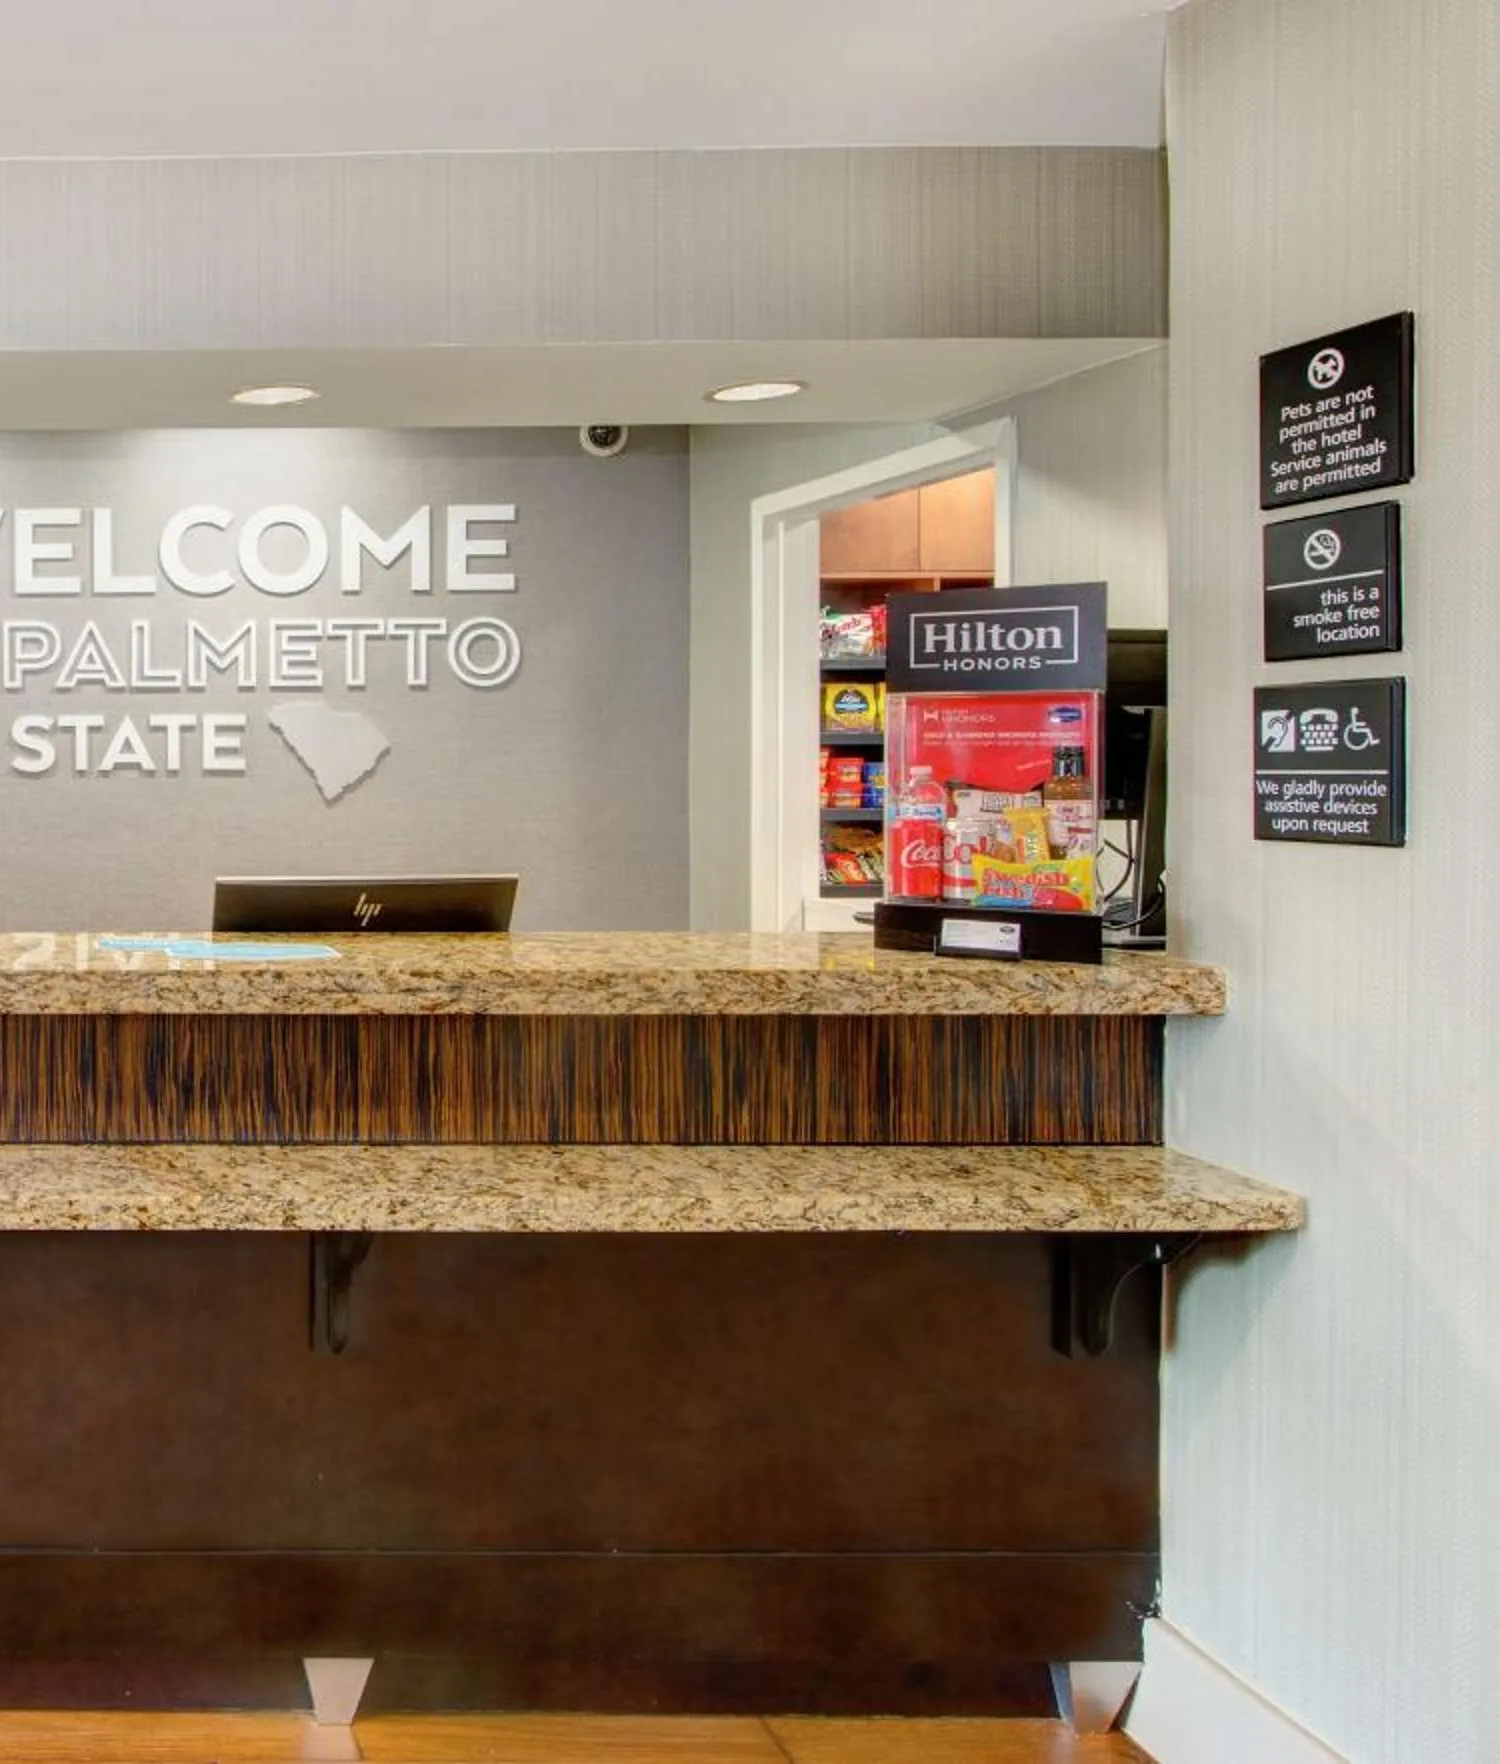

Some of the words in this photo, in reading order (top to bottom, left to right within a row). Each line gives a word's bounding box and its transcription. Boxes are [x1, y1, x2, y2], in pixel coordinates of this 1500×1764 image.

[1281, 402, 1312, 423] Pets
[1315, 395, 1341, 412] are
[1345, 385, 1375, 405] not
[1279, 408, 1355, 444] permitted
[1360, 404, 1376, 420] in
[1292, 437, 1317, 455] the
[1321, 424, 1362, 448] hotel
[1270, 455, 1321, 477] Service
[1325, 439, 1387, 465] animals
[1275, 478, 1299, 494] are
[1303, 458, 1381, 492] permitted
[1320, 588, 1349, 606] this
[1353, 586, 1365, 602] is
[1369, 587, 1380, 600] a
[1293, 610, 1342, 628] smoke
[1347, 605, 1380, 621] free
[924, 621, 1064, 653] Hilton
[1316, 624, 1380, 643] location
[2, 616, 522, 689] PALMETTO
[942, 656, 1042, 672] HONORS
[10, 713, 248, 774] STATE
[1256, 780, 1279, 795] We
[1283, 779, 1325, 800] gladly
[1329, 780, 1388, 801] provide
[1264, 798, 1320, 813] assistive
[1323, 799, 1378, 815] devices
[1271, 817, 1309, 833] upon
[1313, 818, 1370, 836] request
[353, 892, 383, 927] hp
